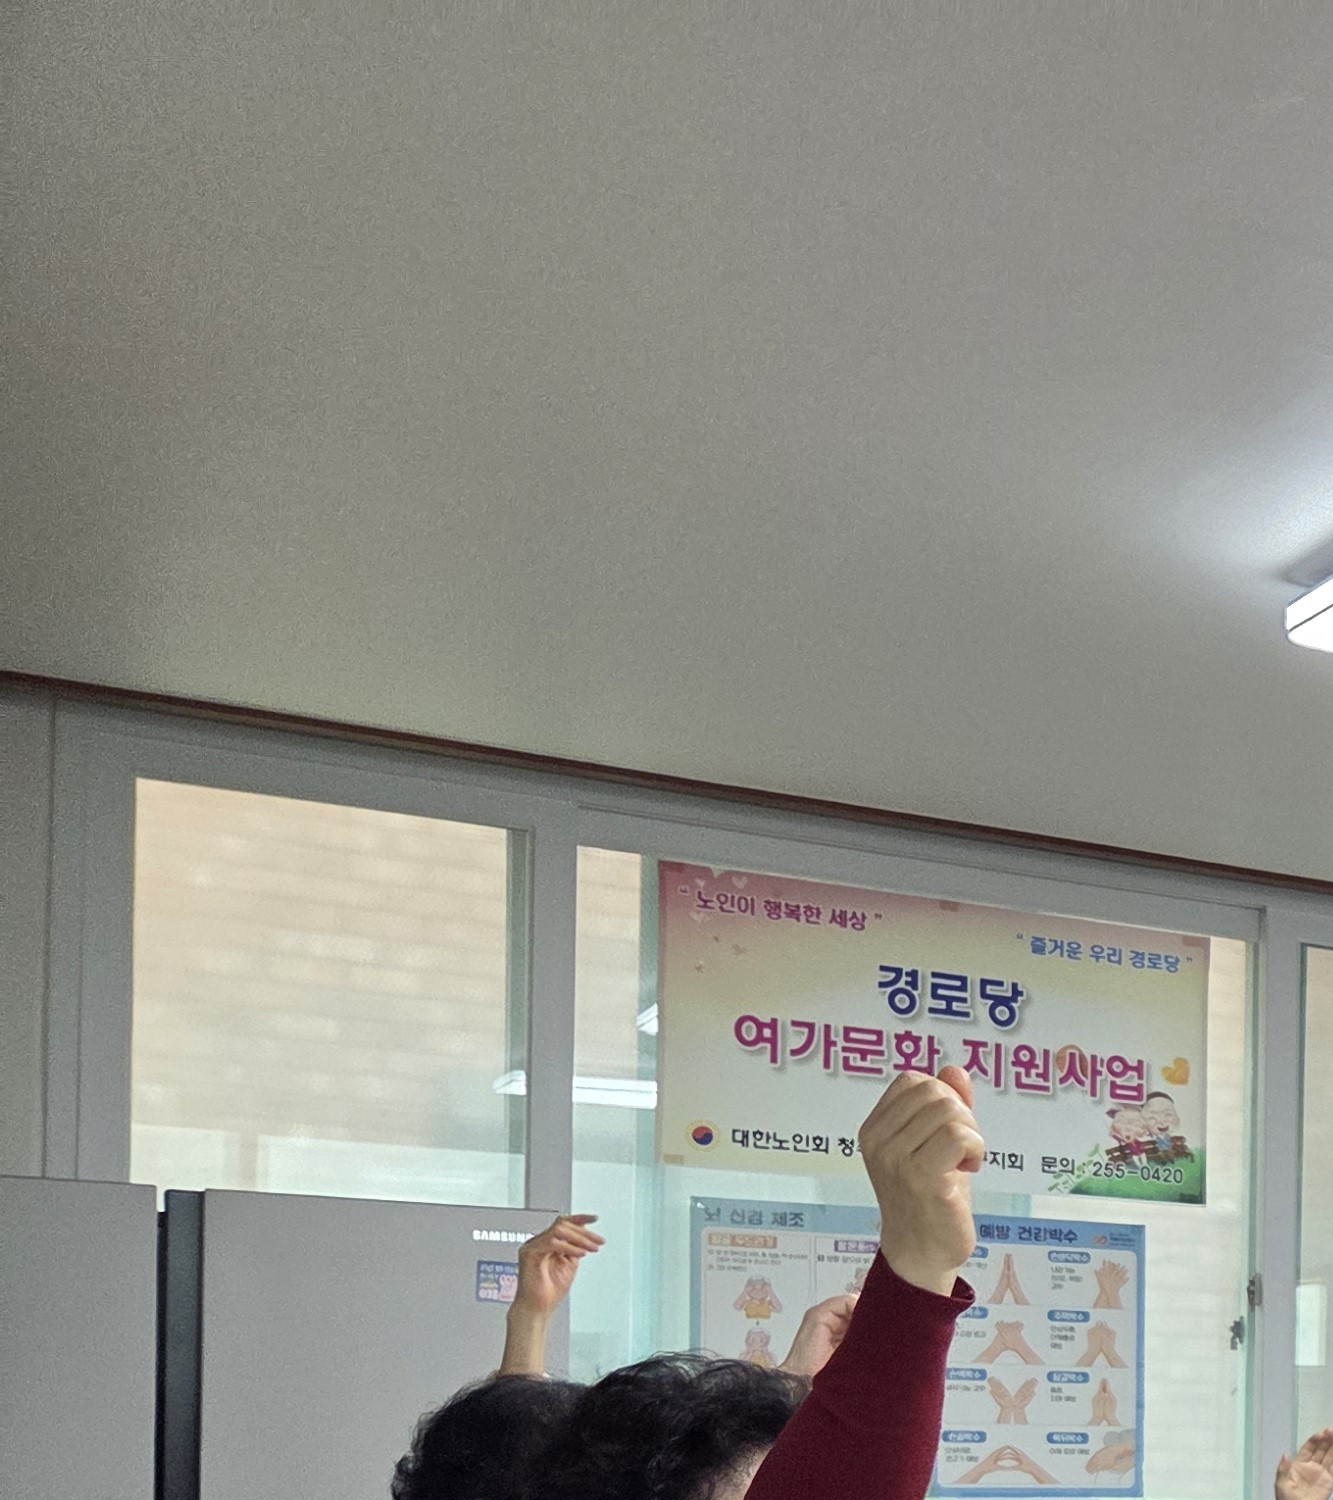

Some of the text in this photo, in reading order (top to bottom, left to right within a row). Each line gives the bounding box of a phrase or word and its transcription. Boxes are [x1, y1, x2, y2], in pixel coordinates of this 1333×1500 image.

[696, 891, 867, 931] 노인이 행복한 세상
[1030, 936, 1181, 973] 즐거운 우리 경로당
[878, 965, 1025, 1027] 경로당
[733, 1014, 1148, 1102] 여가문화 지원사업
[732, 1129, 829, 1154] 대한노인회
[1041, 1156, 1075, 1175] 문의
[1093, 1161, 1183, 1184] 255-0420
[1018, 1225, 1078, 1243] 건강박수
